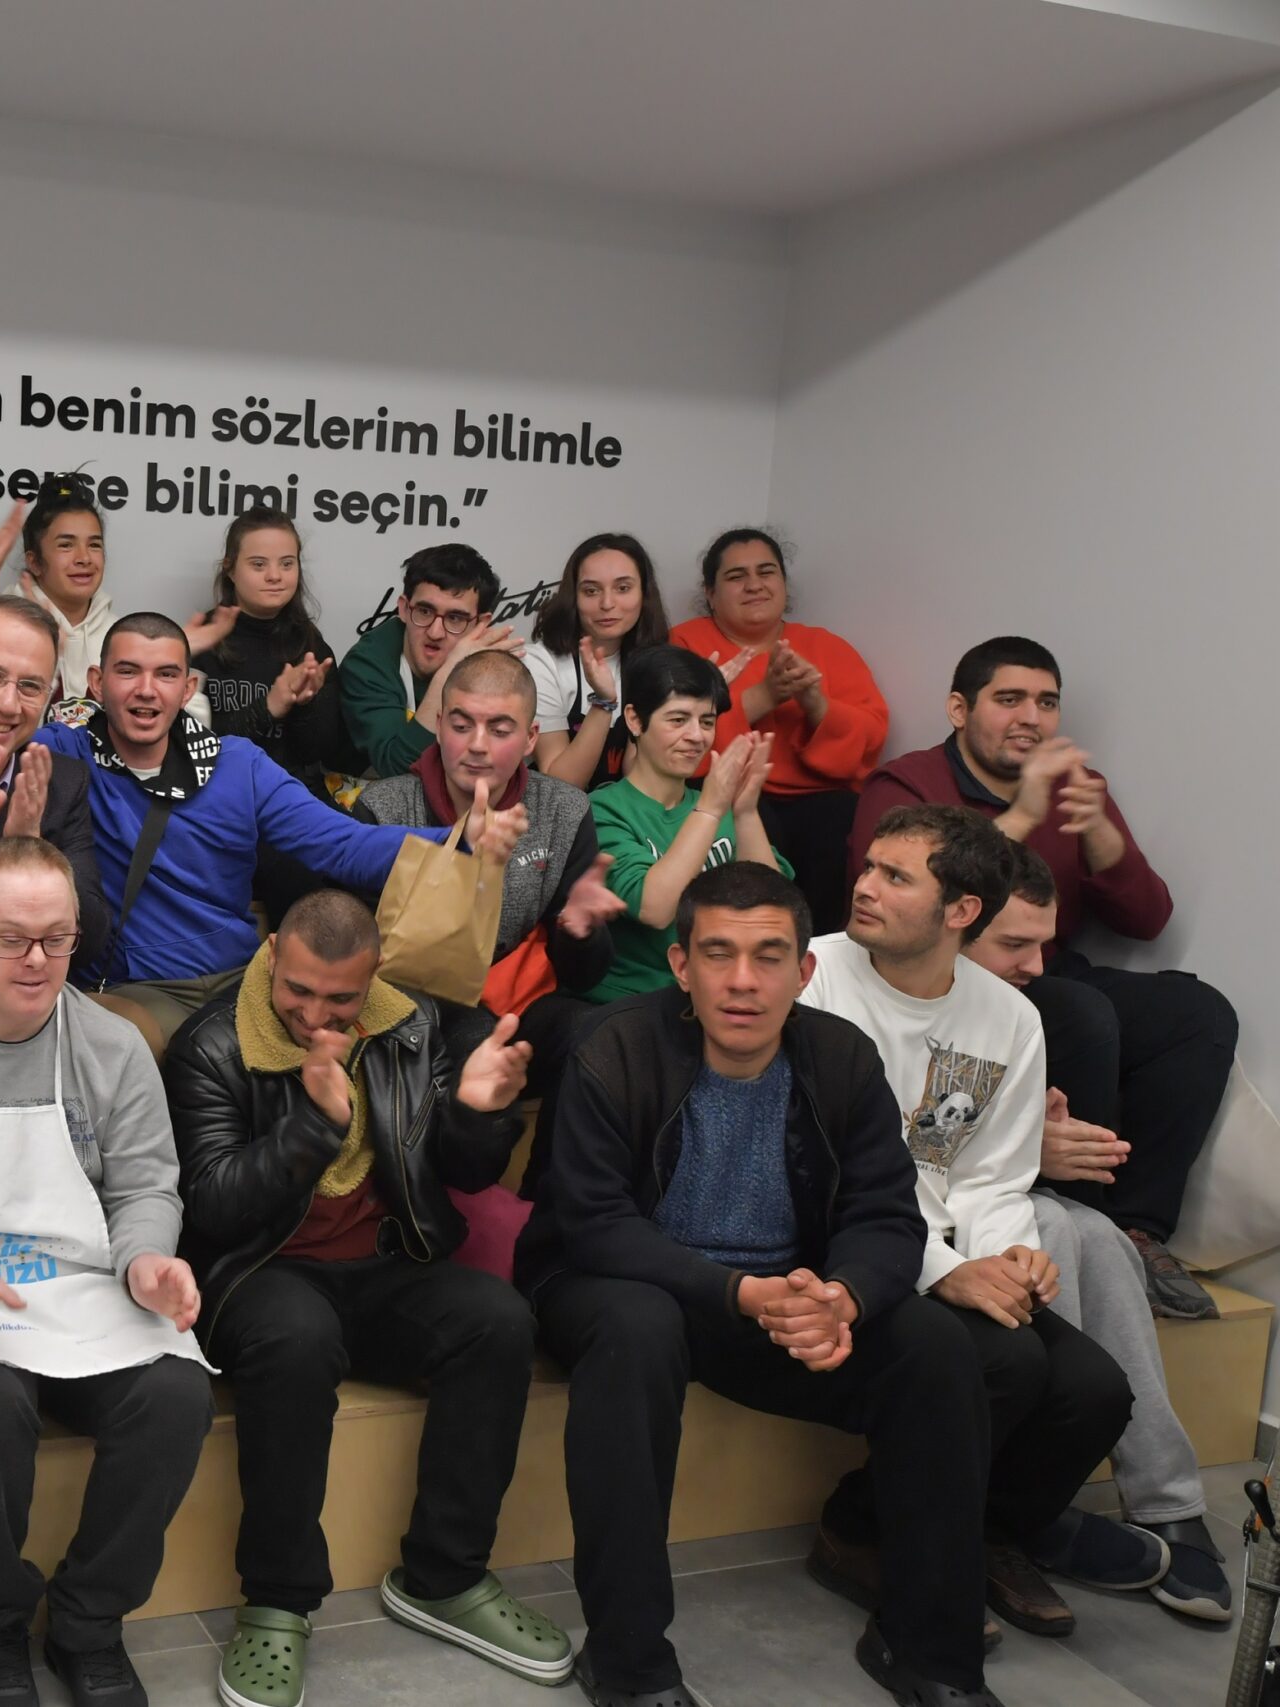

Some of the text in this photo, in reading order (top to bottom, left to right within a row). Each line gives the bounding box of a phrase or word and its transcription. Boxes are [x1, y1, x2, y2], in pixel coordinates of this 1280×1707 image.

[20, 375, 196, 439] benim
[211, 396, 438, 455] sözlerim
[453, 408, 622, 468] bilimle
[146, 462, 299, 519] bilimi
